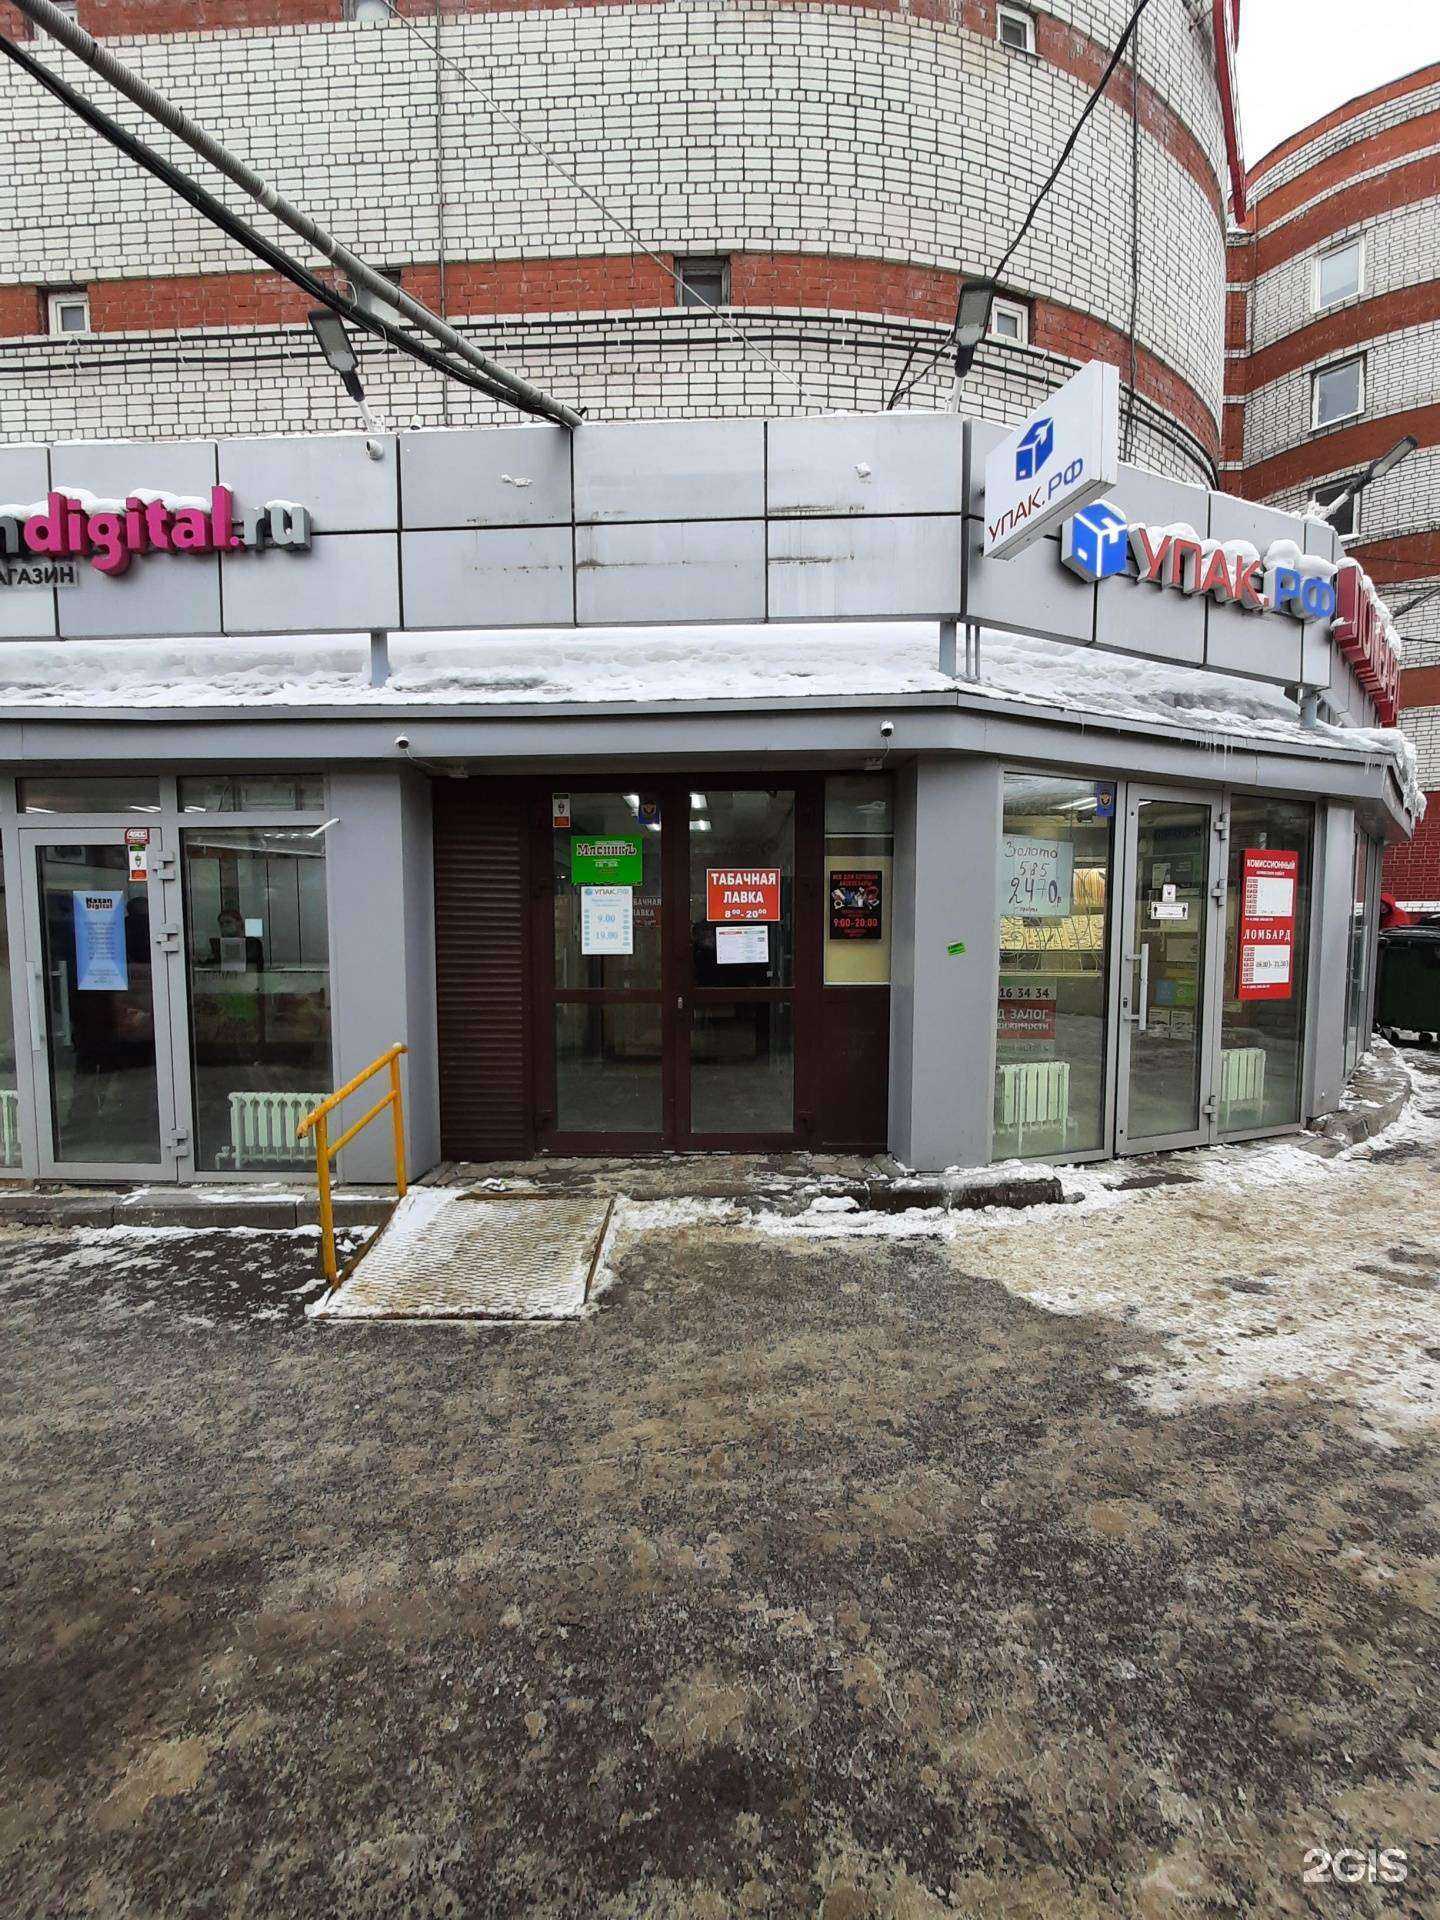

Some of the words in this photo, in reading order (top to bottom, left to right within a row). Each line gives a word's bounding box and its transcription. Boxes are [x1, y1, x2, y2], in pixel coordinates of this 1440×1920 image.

[988, 458, 1084, 542] УПАК.РФ
[1131, 527, 1336, 621] УПАК.РФ
[1005, 841, 1058, 859] Золото
[1020, 861, 1050, 877] 585
[711, 872, 776, 886] ТАБАЧНАЯ
[723, 891, 764, 904] ЛАВКА
[1243, 929, 1291, 941] ЛОМБАРД
[1010, 1009, 1049, 1020] ЗАЛОГ
